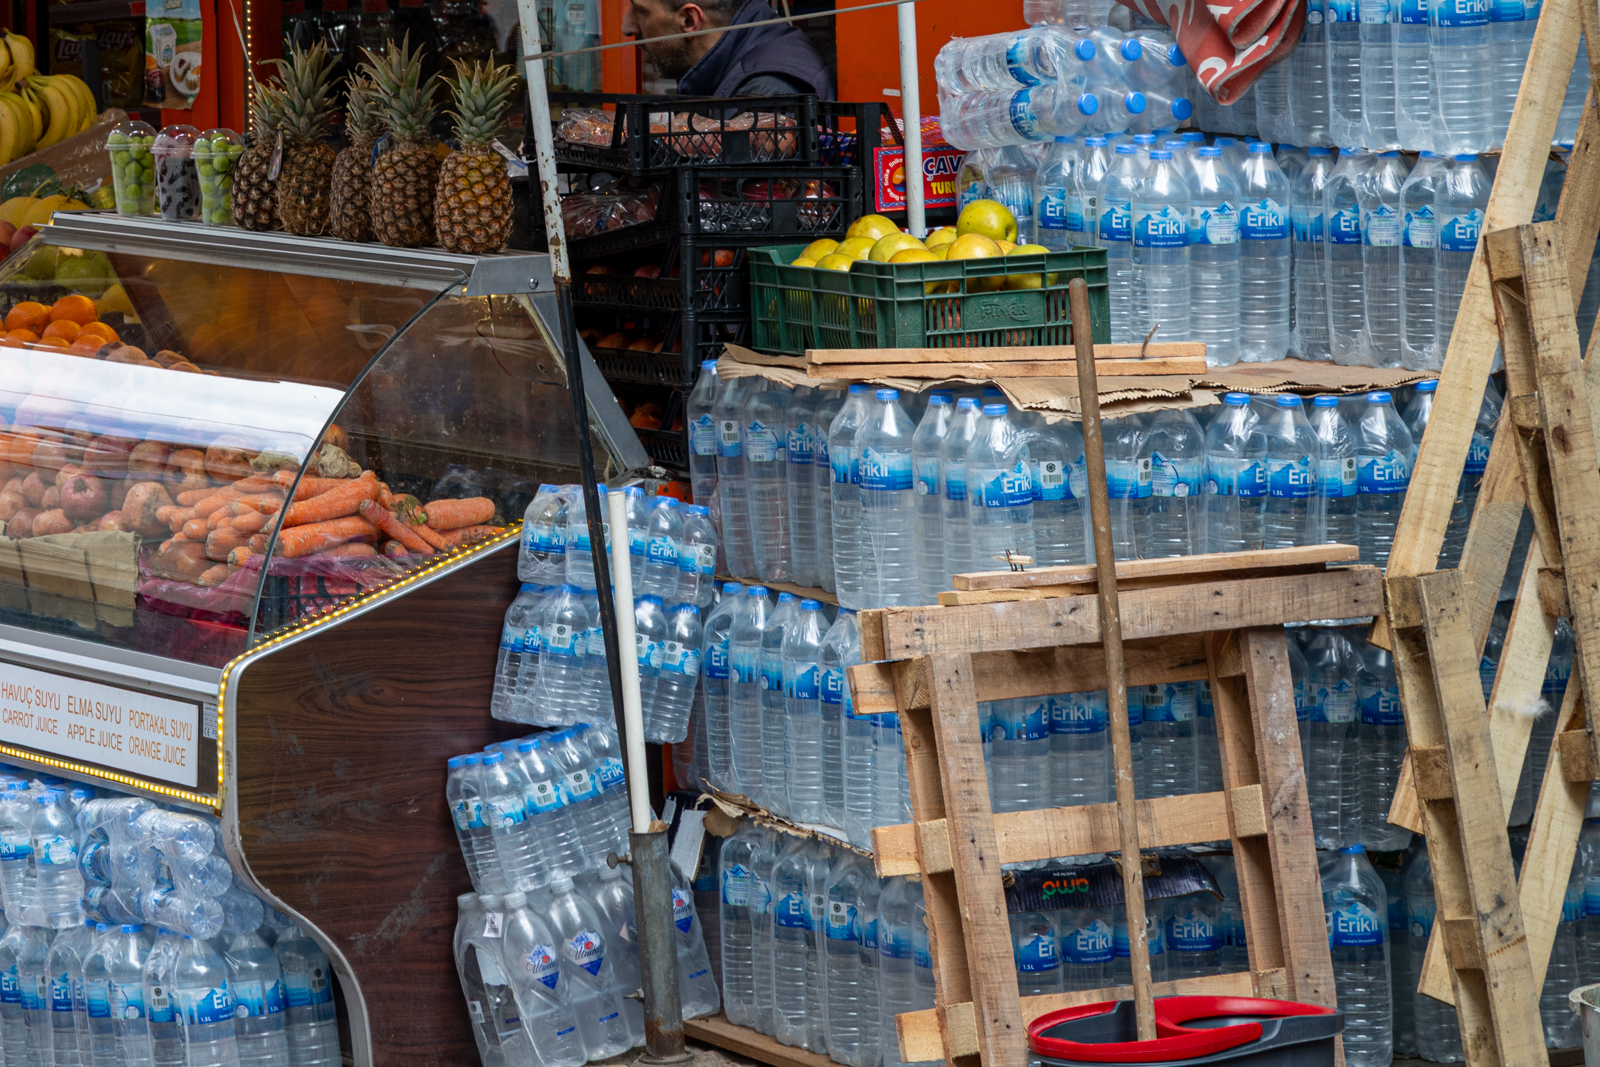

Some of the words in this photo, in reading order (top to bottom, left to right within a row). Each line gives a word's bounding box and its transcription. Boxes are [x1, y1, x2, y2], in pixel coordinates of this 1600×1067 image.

[1017, 101, 1032, 134] Erik
[1147, 220, 1185, 235] Erikli
[1247, 211, 1284, 227] Erikli
[1289, 470, 1316, 485] Erik
[1, 682, 33, 709] HAVUÇ
[34, 689, 61, 711] SUYU
[67, 695, 94, 718] ELMA
[95, 701, 122, 725] SUYU
[1052, 704, 1093, 720] Erikli
[2, 708, 35, 730] CARROT
[35, 716, 58, 735] JUICE
[129, 709, 169, 736] PORTAKAL
[170, 718, 193, 742] SUYU
[67, 723, 95, 745] APPLE
[97, 730, 123, 752] JUICE
[128, 735, 161, 761] ORANGE
[163, 745, 186, 767] JUICE
[601, 765, 624, 782] Erik
[1173, 922, 1213, 938] Erikli
[1337, 916, 1379, 933] Erikli
